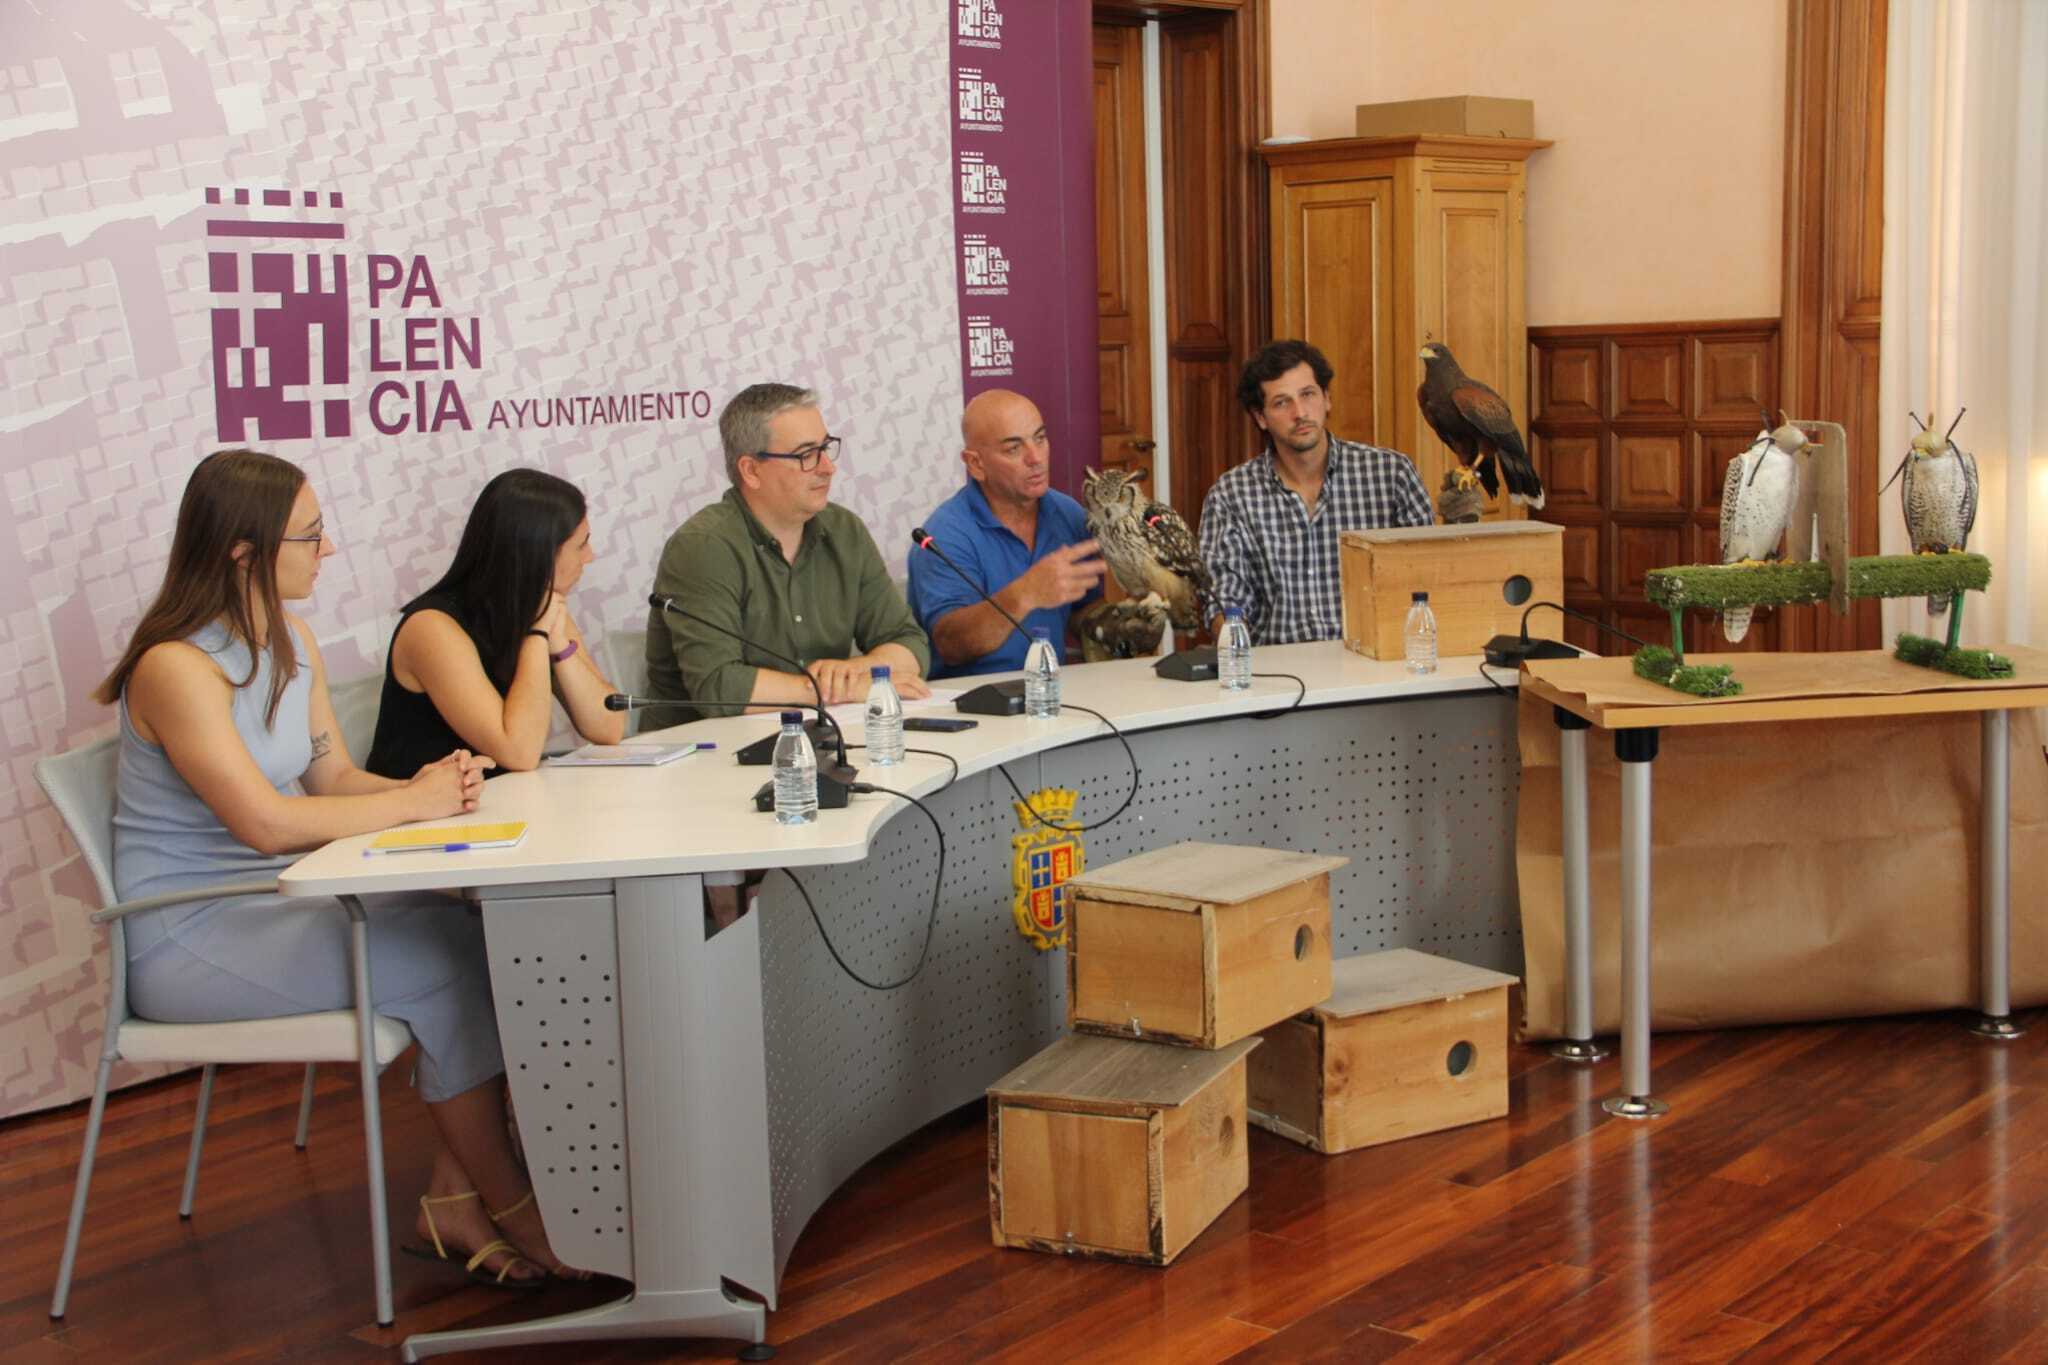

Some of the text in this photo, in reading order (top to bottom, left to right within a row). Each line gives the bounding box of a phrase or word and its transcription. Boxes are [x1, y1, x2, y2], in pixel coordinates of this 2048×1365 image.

[982, 0, 997, 12] PA
[982, 12, 1003, 26] LEN
[982, 25, 1001, 39] CIA
[983, 82, 998, 95] PA
[983, 95, 1005, 108] LEN
[984, 109, 1003, 122] CIA
[985, 165, 1000, 178] PA
[986, 178, 1007, 191] LEN
[986, 191, 1005, 204] CIA
[988, 246, 1002, 259] PA
[989, 259, 1010, 272] LEN
[367, 254, 442, 309] PA
[989, 272, 1008, 285] CIA
[992, 327, 1007, 340] PA
[369, 317, 483, 372] LEN
[993, 340, 1014, 353] LEN
[993, 353, 1012, 366] CIA
[368, 379, 473, 436] CIA
[487, 390, 711, 430] AYUNTAMIENTO
